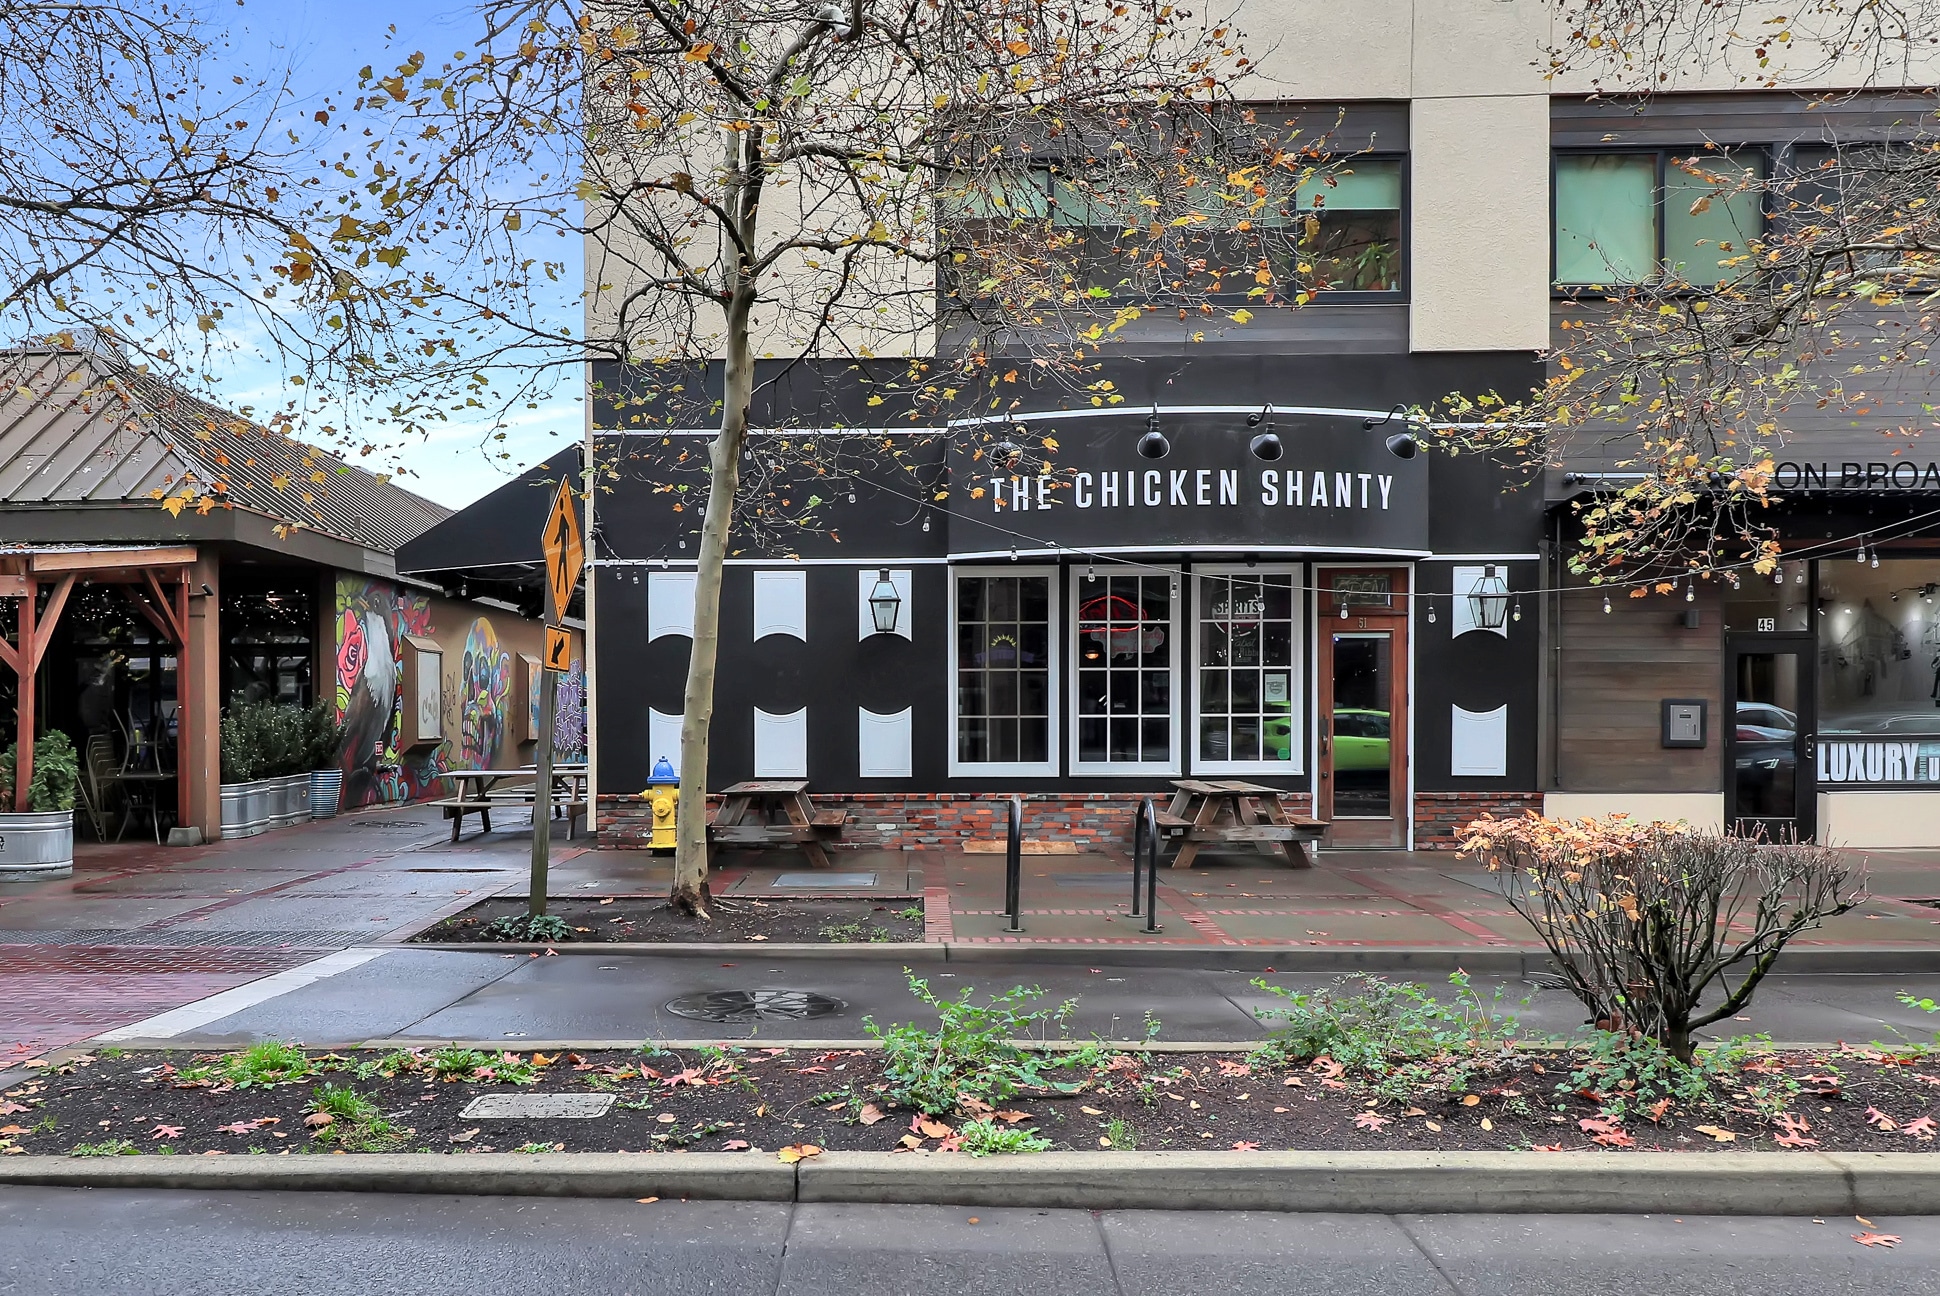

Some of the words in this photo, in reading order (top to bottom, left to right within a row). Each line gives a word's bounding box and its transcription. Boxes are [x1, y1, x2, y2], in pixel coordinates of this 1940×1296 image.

[1775, 462, 1827, 489] ON
[1841, 461, 1940, 489] BROA
[990, 475, 1052, 513] THE
[1075, 469, 1238, 508] CHICKEN
[1261, 469, 1393, 510] SHANTY
[1216, 600, 1259, 614] SPRITS
[1358, 617, 1367, 629] 51
[1759, 619, 1773, 631] 45
[1817, 743, 1919, 781] LUXURY
